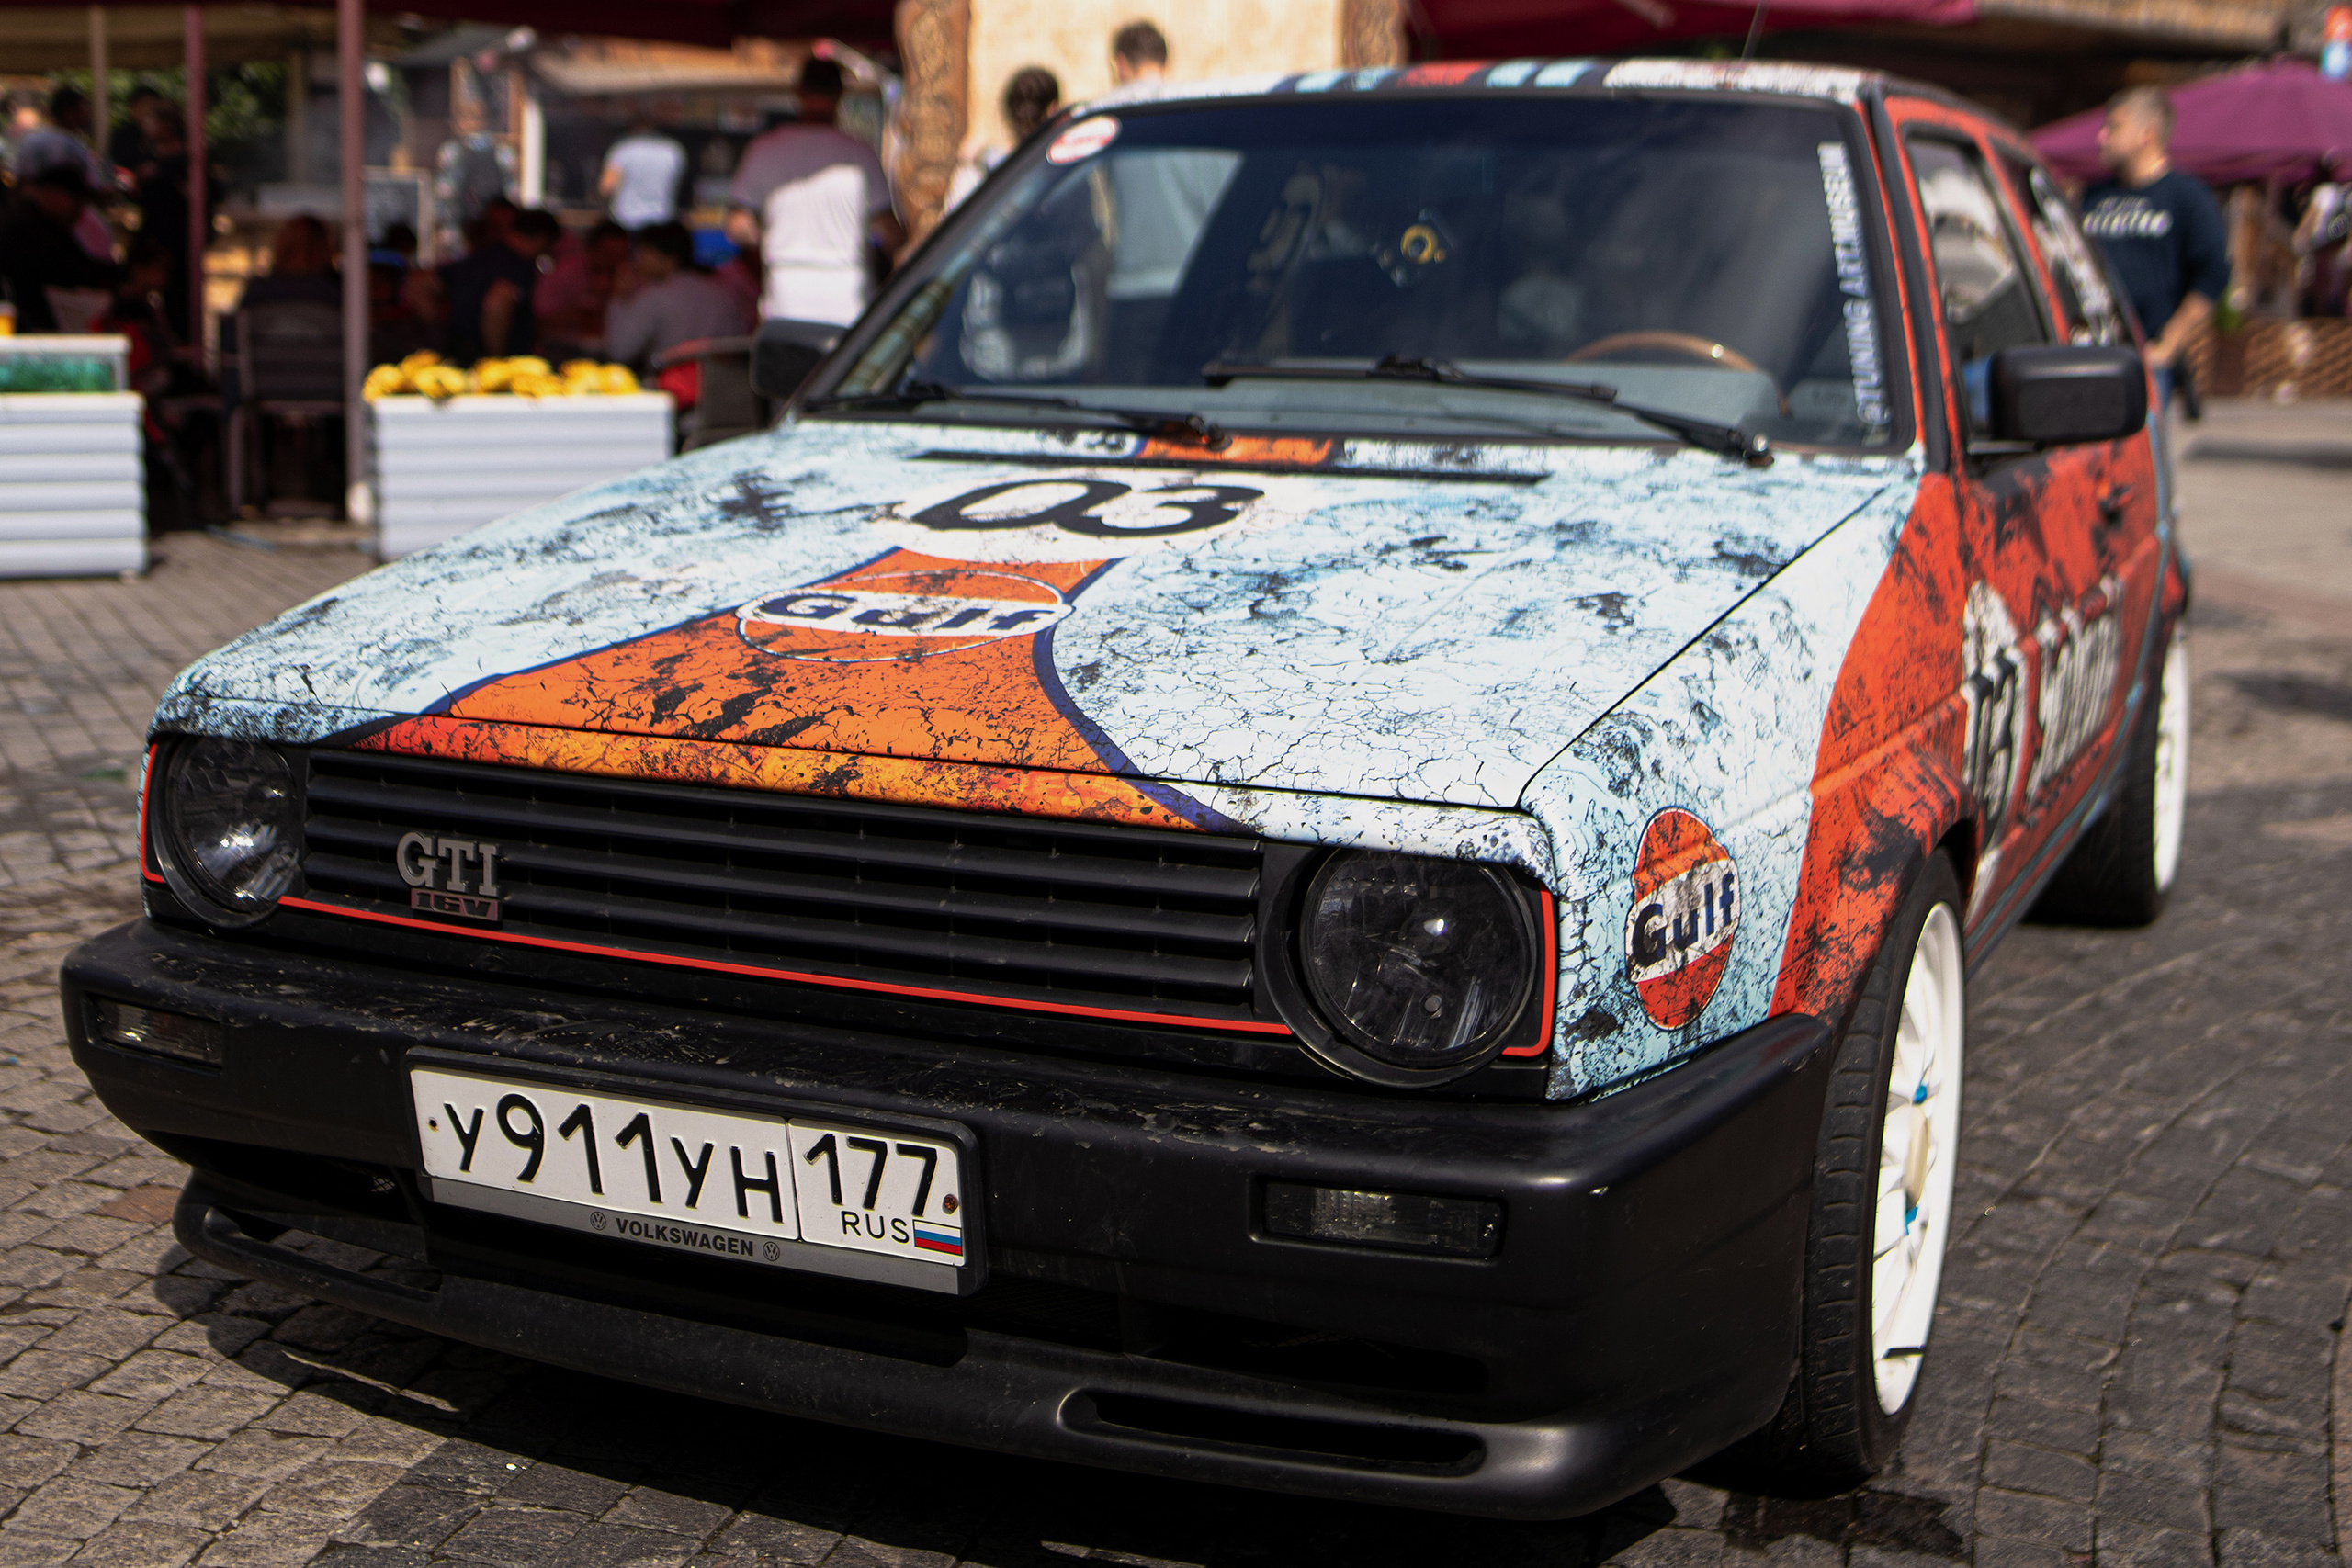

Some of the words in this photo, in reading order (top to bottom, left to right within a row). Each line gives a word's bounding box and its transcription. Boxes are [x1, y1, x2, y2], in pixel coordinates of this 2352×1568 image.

[911, 479, 1265, 537] 03
[758, 592, 1057, 631] Gulf
[396, 830, 500, 897] GTI
[1632, 872, 1736, 968] Gulf
[804, 1133, 939, 1218] 177
[615, 1217, 754, 1258] VOLKSWAGEN
[840, 1210, 910, 1246] RUS
